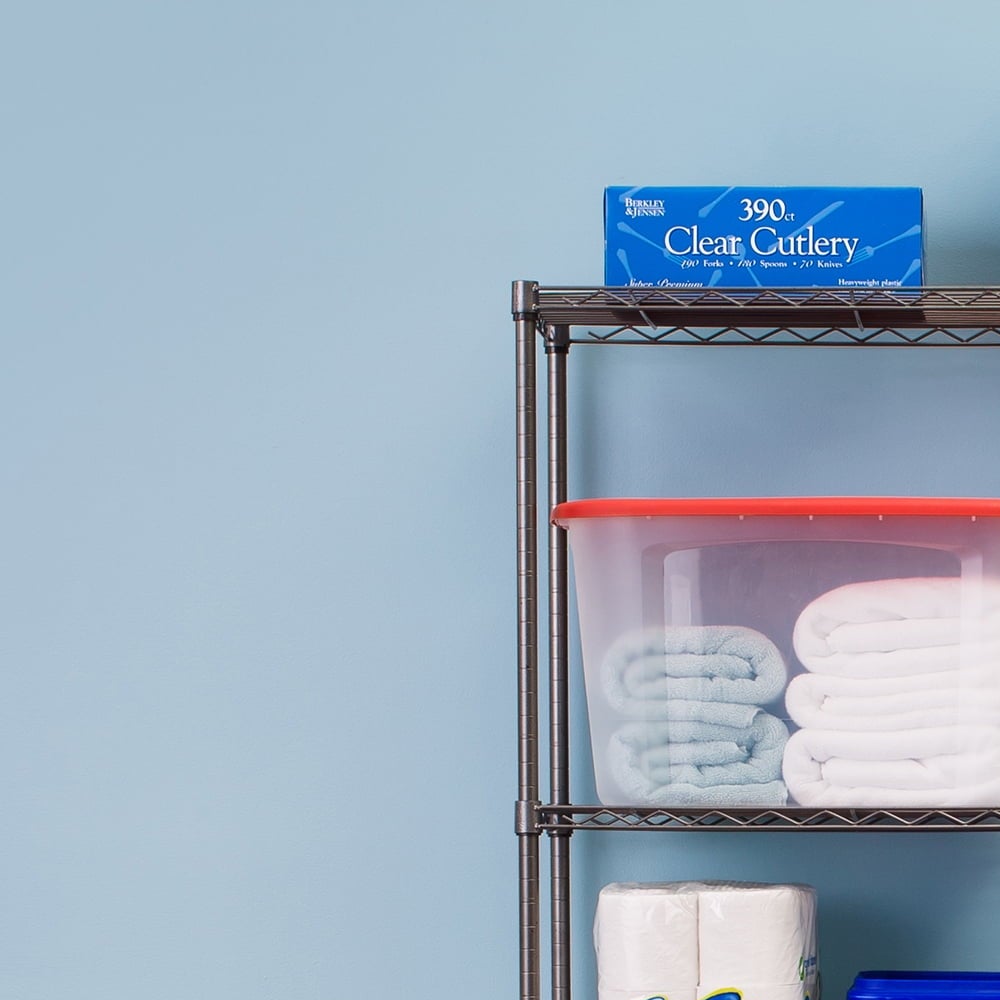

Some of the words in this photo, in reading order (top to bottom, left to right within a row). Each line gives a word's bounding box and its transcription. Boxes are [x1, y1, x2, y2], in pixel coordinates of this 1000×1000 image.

[625, 198, 664, 207] BERKLEY
[664, 225, 743, 255] Clear
[750, 225, 859, 263] Cutlery
[703, 260, 724, 268] Forks
[760, 260, 788, 269] Spoons
[817, 260, 843, 268] Knives
[838, 279, 880, 287] Heavyweight
